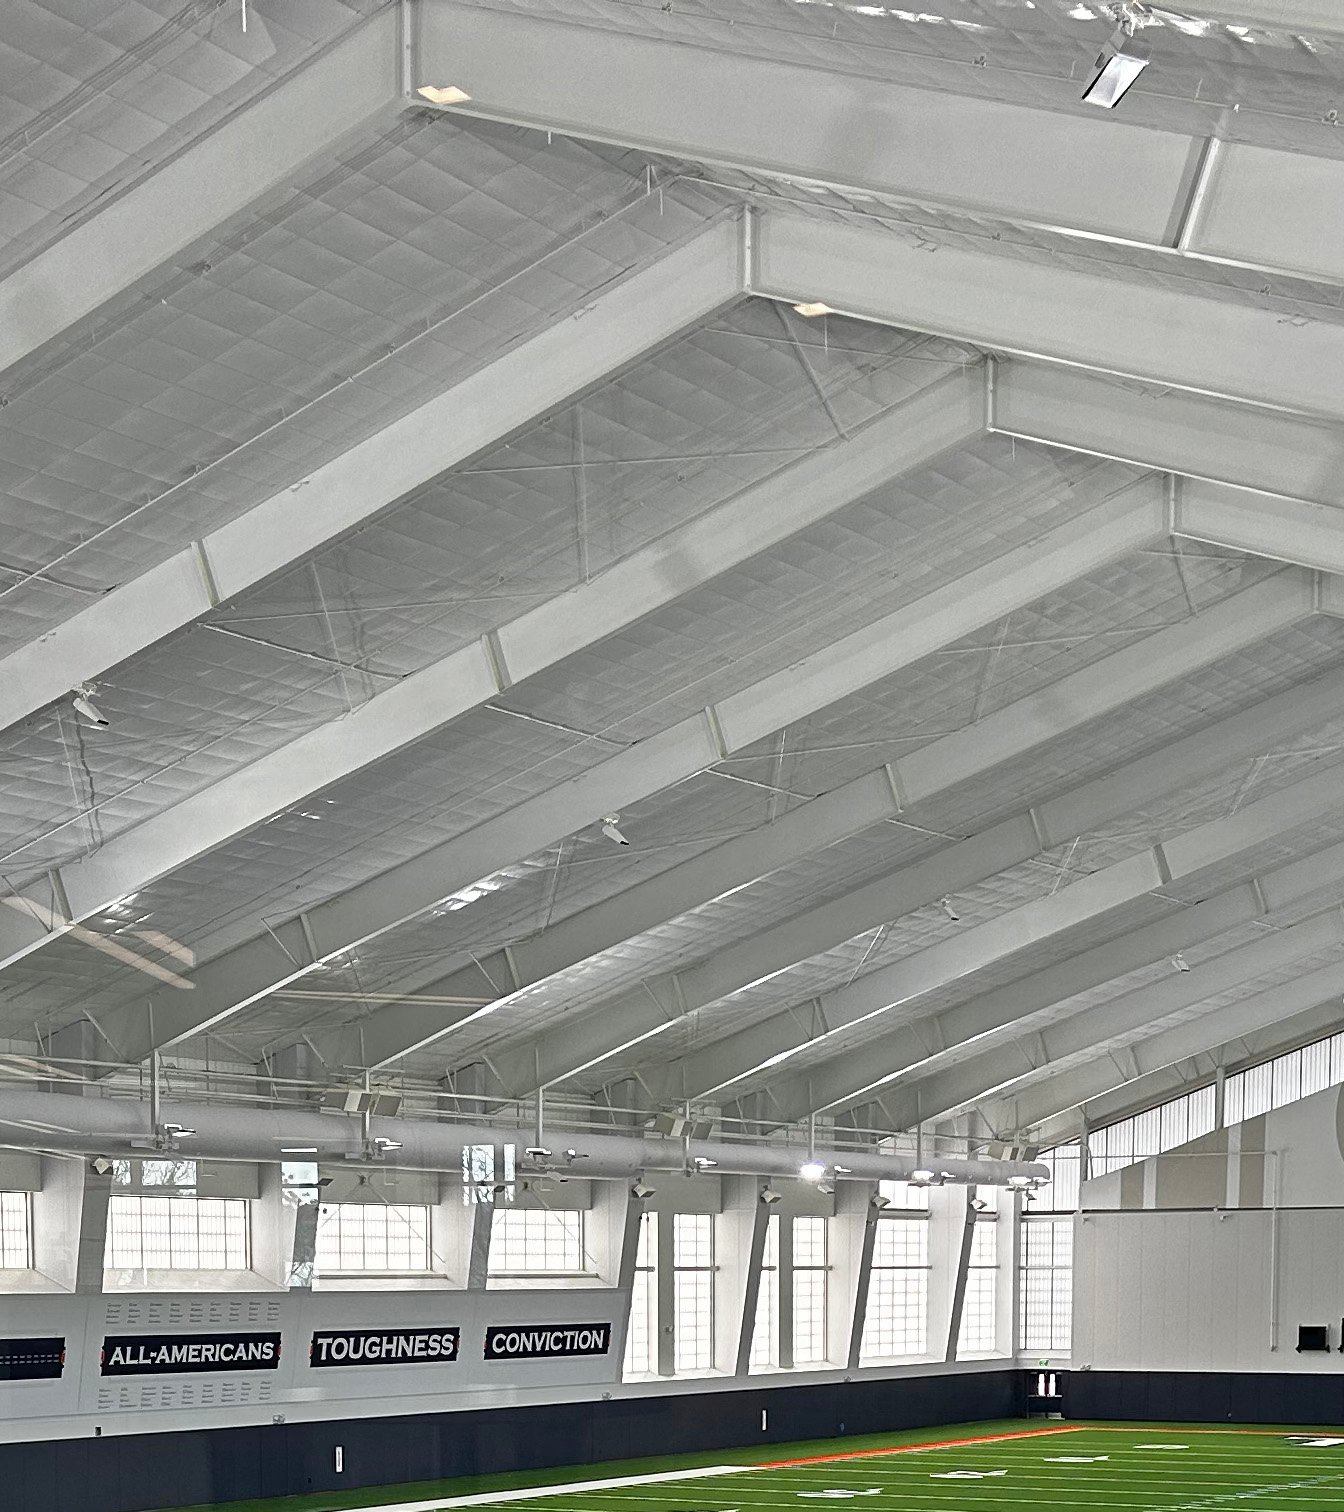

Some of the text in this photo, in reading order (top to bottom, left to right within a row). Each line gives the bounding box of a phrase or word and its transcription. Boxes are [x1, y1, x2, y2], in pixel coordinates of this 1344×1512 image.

[109, 1342, 275, 1366] ALL-AMERICANS
[317, 1334, 455, 1361] TOUGHNESS
[492, 1330, 605, 1354] CONVICTION
